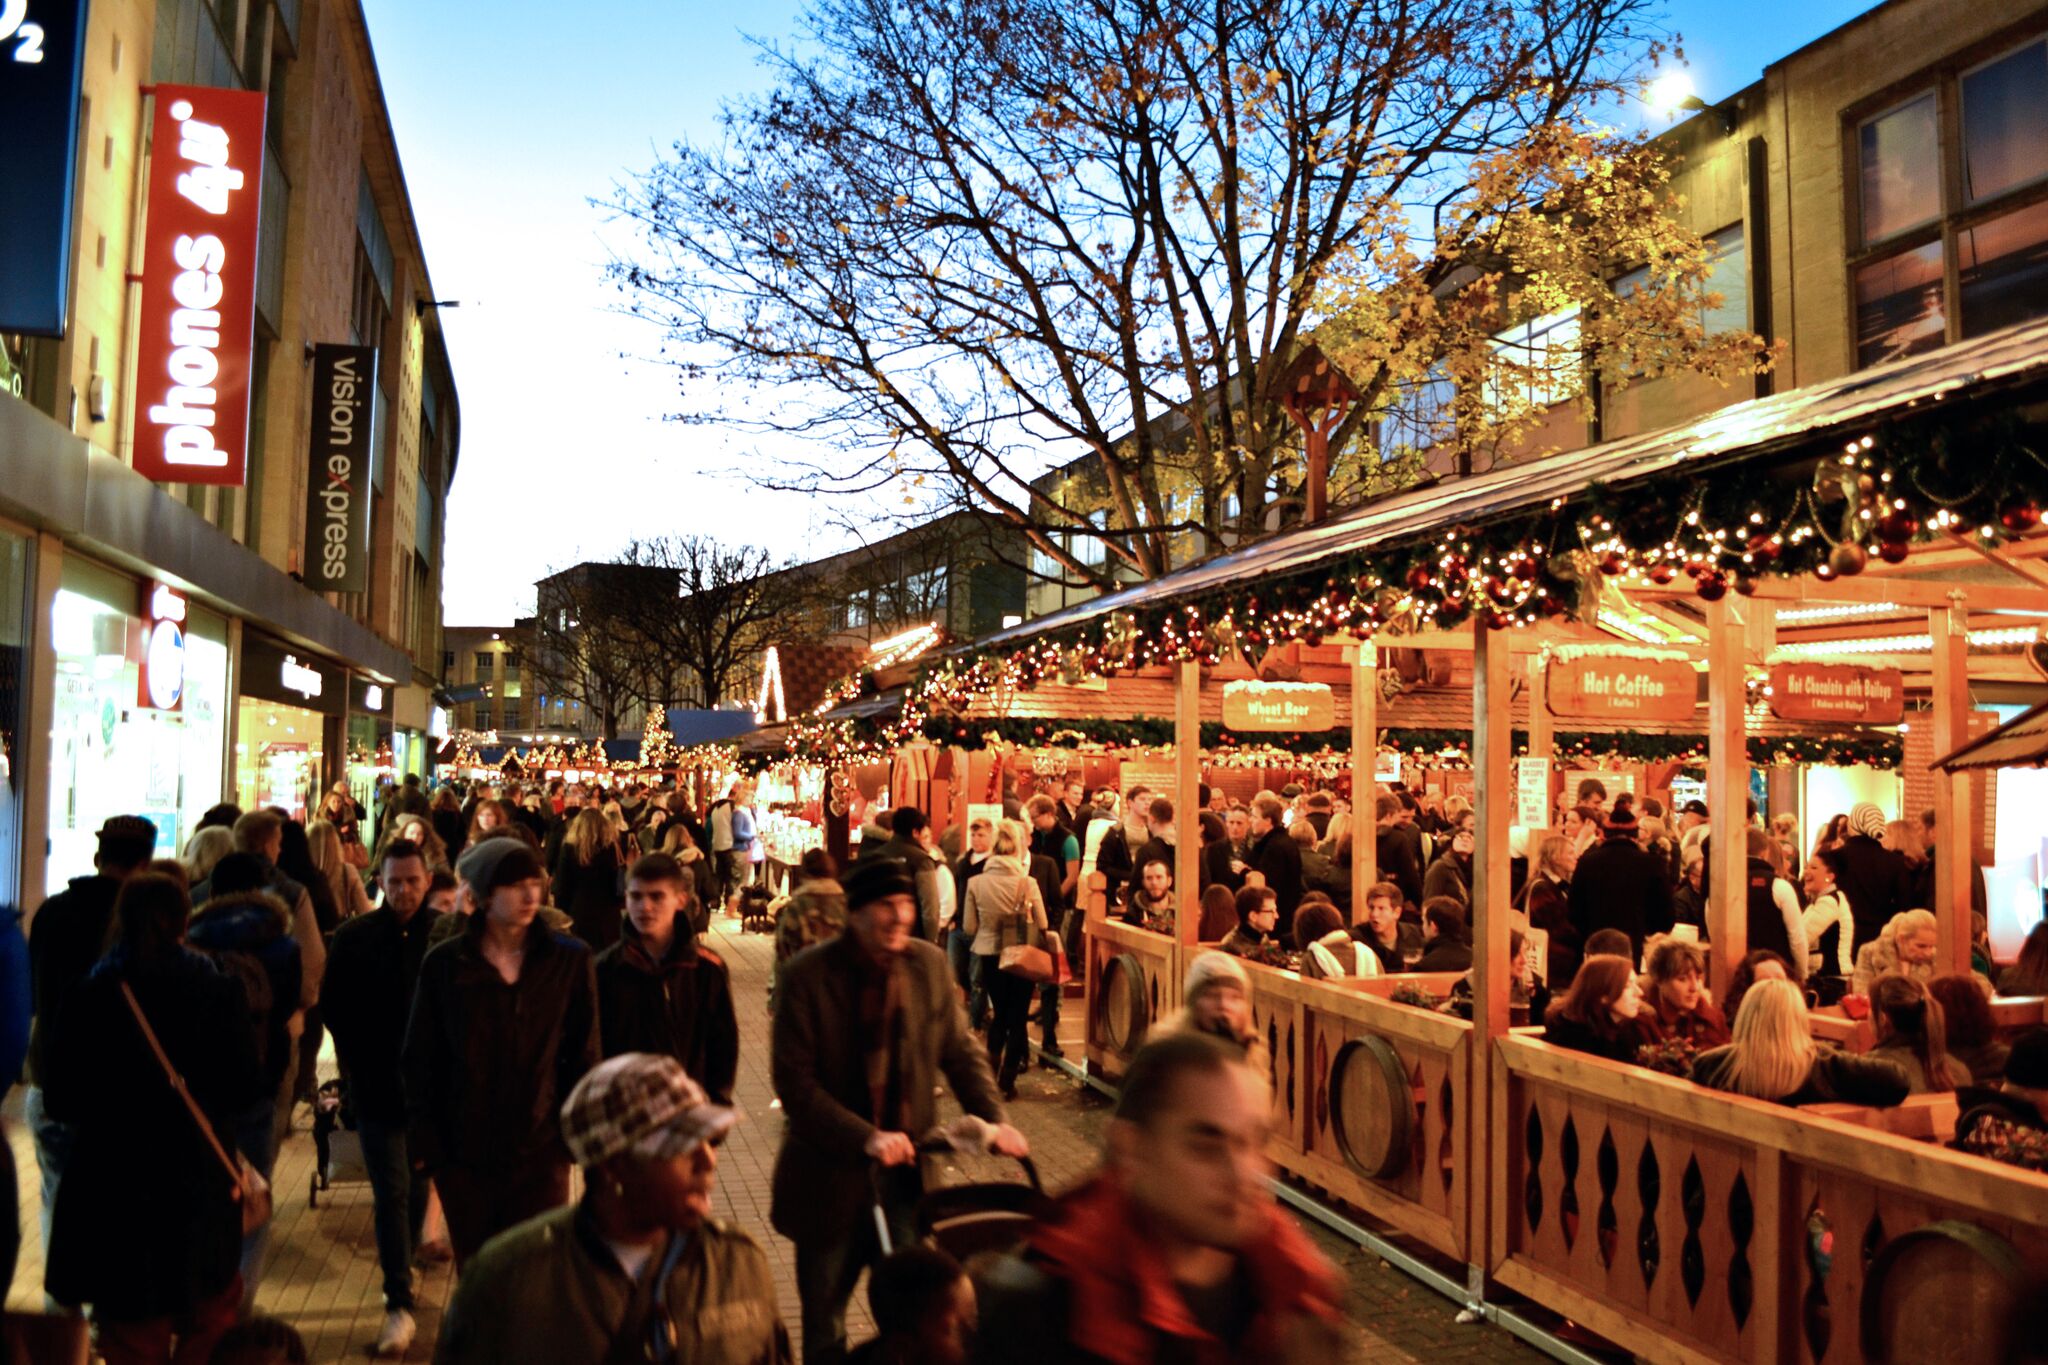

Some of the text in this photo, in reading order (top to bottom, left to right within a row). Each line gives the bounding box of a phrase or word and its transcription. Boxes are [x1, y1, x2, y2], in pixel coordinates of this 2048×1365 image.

[149, 234, 229, 467] phones
[319, 357, 363, 580] vision express
[1584, 671, 1665, 697] Hot Coffee
[1787, 674, 1892, 702] Hot Chocolate with Baileys
[1247, 700, 1309, 716] Wheat Beer
